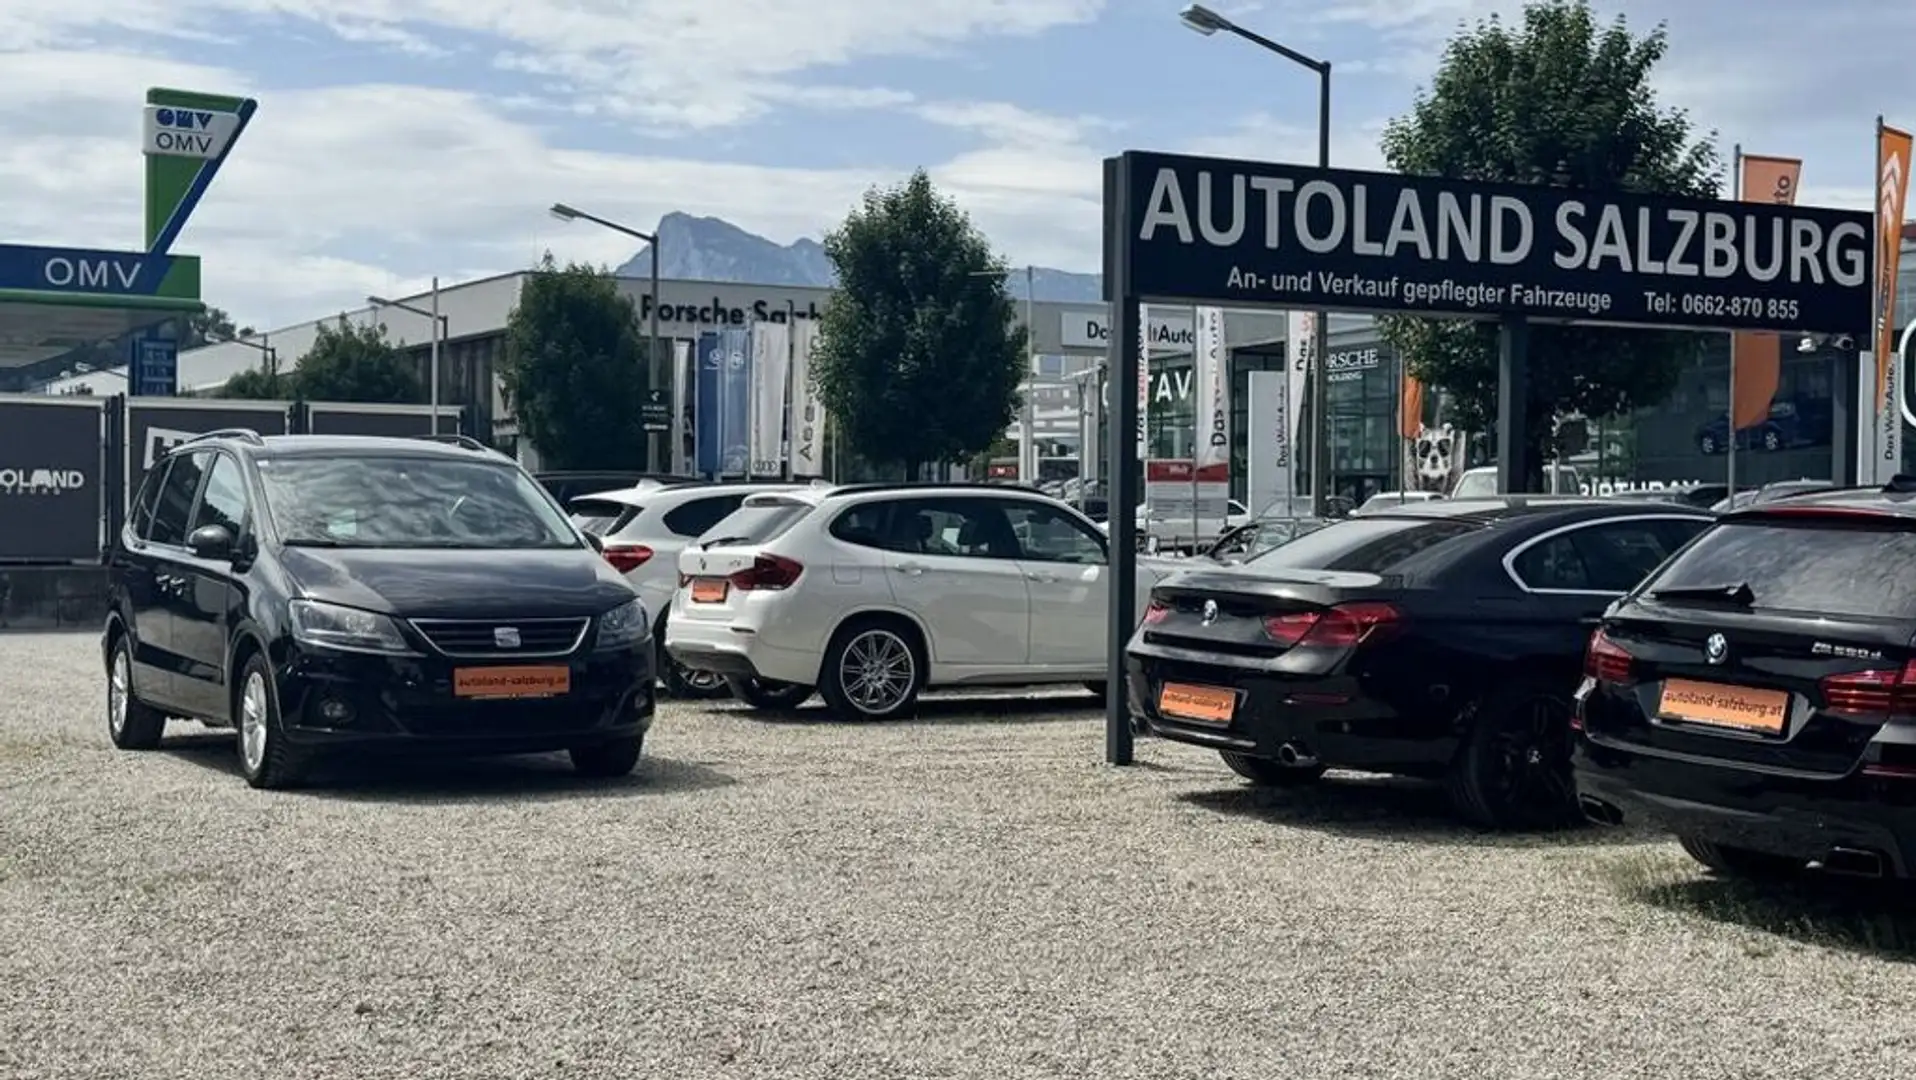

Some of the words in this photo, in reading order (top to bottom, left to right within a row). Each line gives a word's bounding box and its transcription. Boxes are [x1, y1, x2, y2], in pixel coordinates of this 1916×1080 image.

[156, 132, 213, 154] OMV
[1139, 167, 1534, 265] AUTOLAND
[1553, 200, 1866, 287] SALZBURG
[45, 257, 142, 289] OMV
[1227, 266, 1266, 290] An-
[1272, 270, 1312, 293] und
[1319, 271, 1399, 298] Verkauf
[1404, 277, 1506, 308] gepflegter
[1511, 284, 1612, 315] Fahrzeuge
[1644, 290, 1677, 313] Tel:
[1682, 292, 1763, 319] 0662-870
[1768, 298, 1800, 321] 855
[1663, 691, 1783, 718] autoland-salzburg.at
